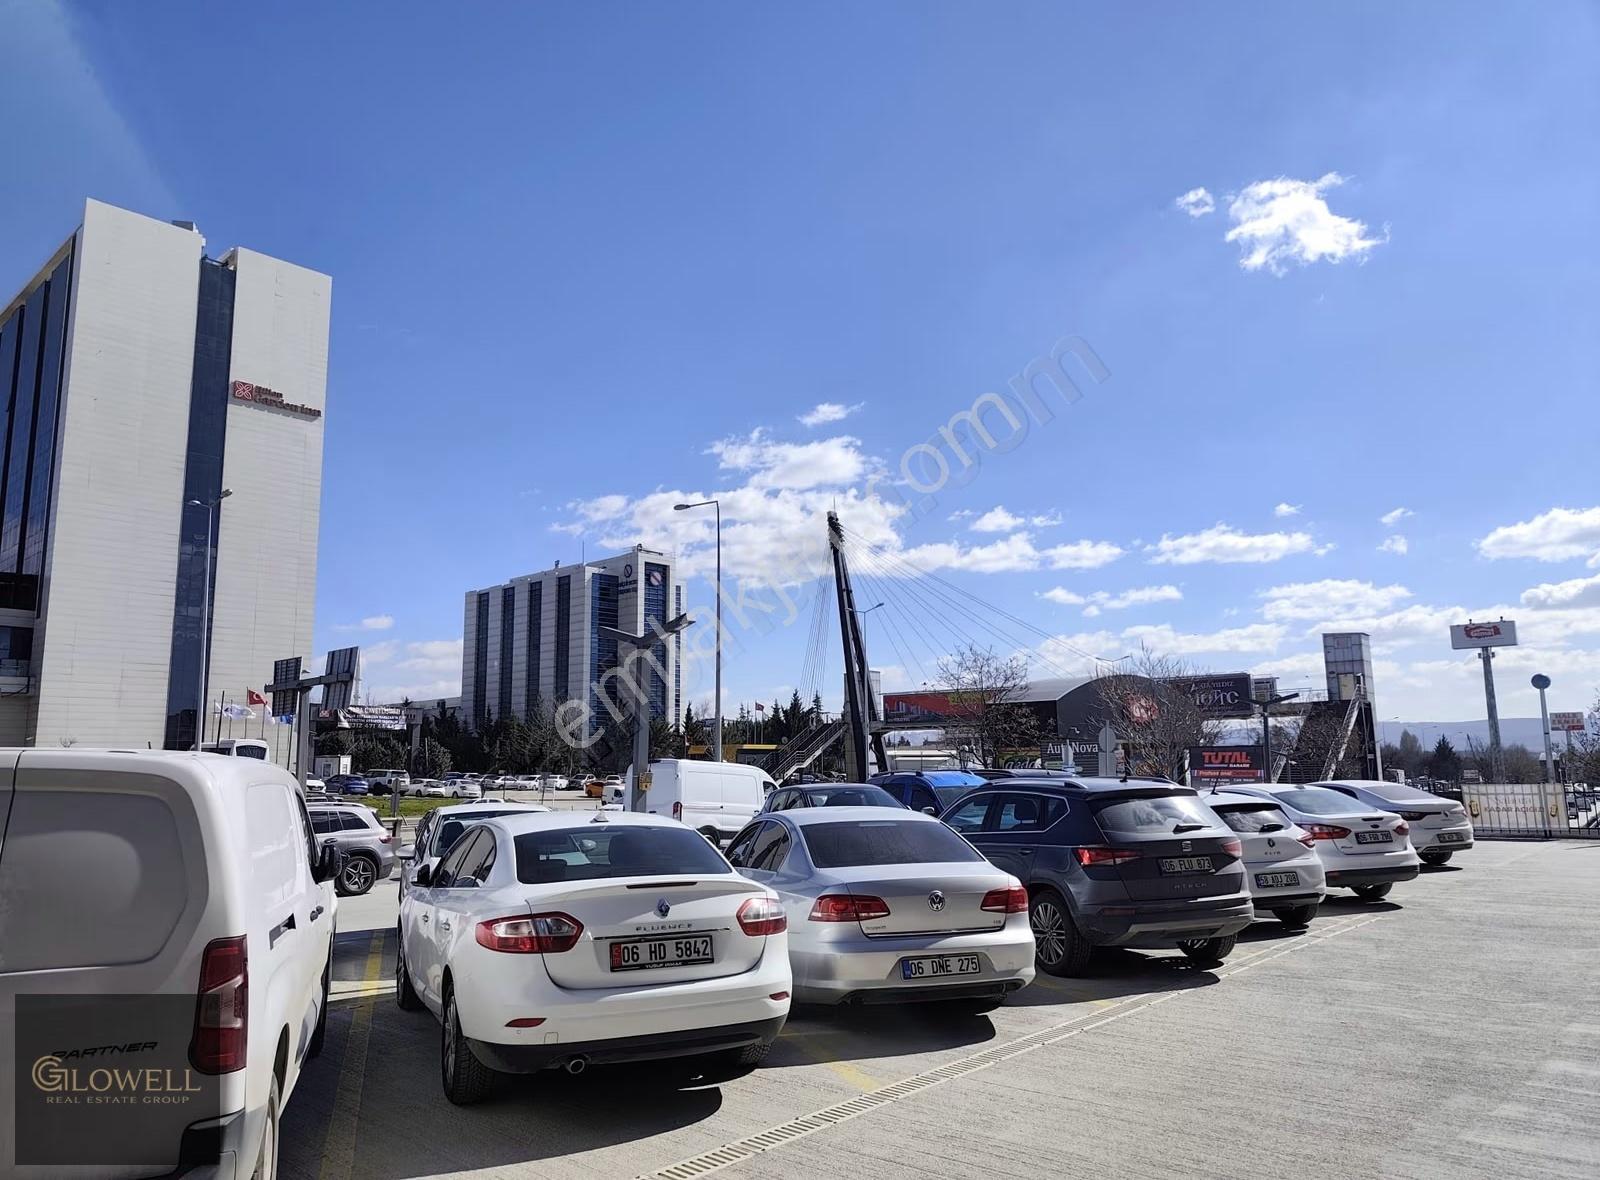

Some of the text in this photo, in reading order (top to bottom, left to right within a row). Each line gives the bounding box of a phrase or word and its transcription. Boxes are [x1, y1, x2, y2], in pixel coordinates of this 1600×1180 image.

[1047, 742, 1099, 754] AutNova
[1178, 859, 1193, 870] FLU
[622, 943, 640, 963] 06
[649, 943, 666, 961] HD
[674, 939, 710, 958] 5842
[910, 961, 924, 975] 06
[931, 959, 952, 974] DNE
[958, 957, 978, 972] 275
[50, 1041, 159, 1060] PARTNER
